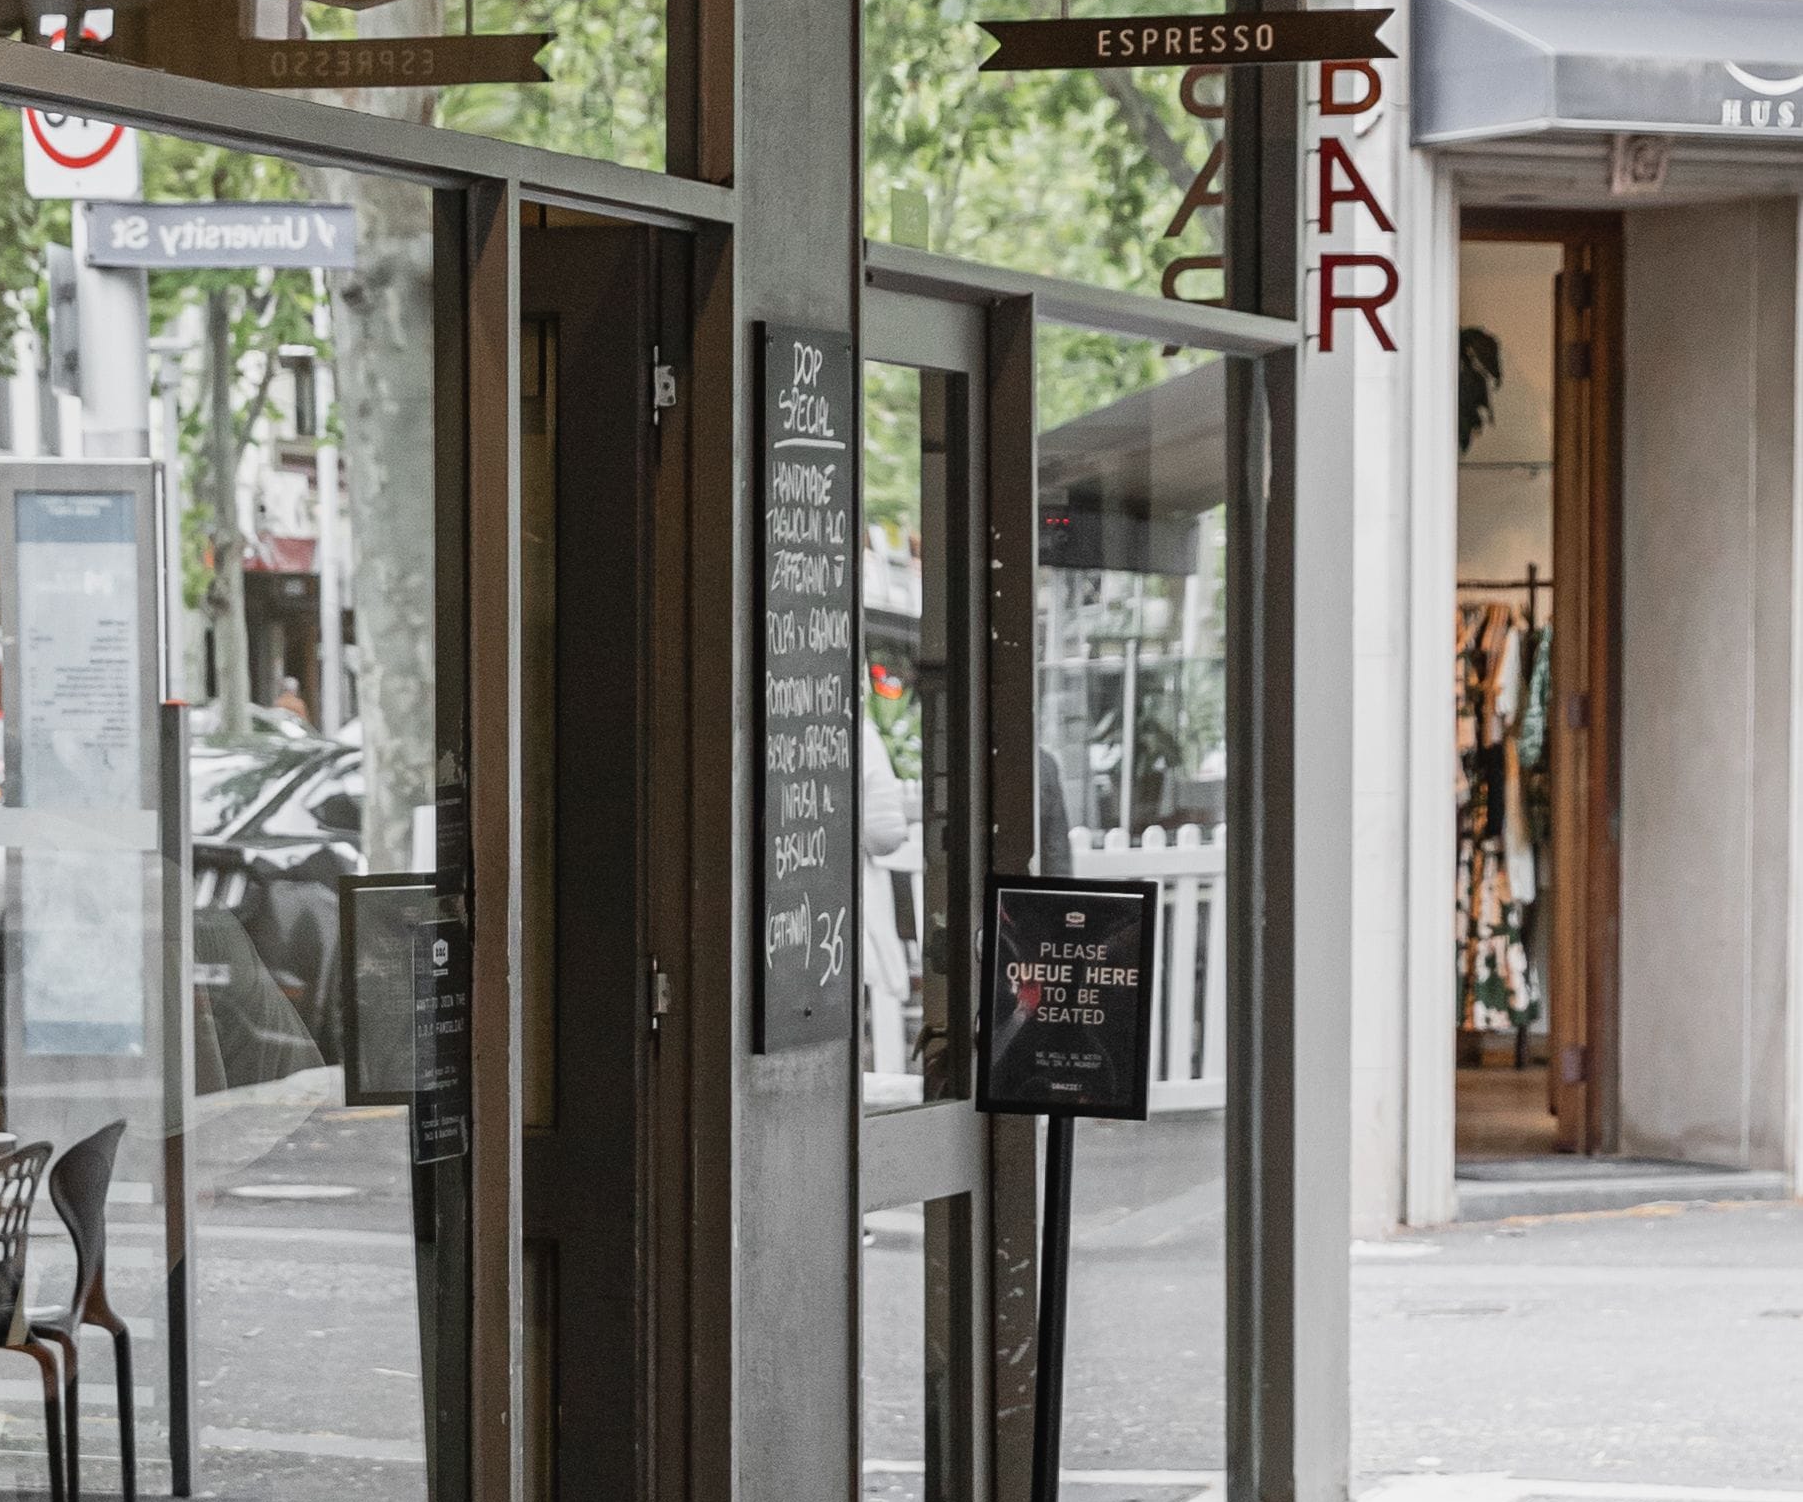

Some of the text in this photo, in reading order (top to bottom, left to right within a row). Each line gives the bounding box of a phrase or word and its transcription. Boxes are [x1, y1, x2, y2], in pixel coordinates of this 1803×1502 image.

[1097, 23, 1275, 57] ESPRESSO
[1722, 99, 1803, 129] HUS
[793, 341, 823, 388] DOP
[778, 387, 835, 438] SPECIAL
[772, 460, 837, 506] HANDMADE
[774, 825, 827, 880] BASILICO
[816, 906, 847, 987] 36
[1039, 942, 1108, 961] PLEASE
[1006, 962, 1139, 987] QUEUE HERE
[1043, 986, 1100, 1005] TO BE
[1036, 1006, 1105, 1026] SEATED
